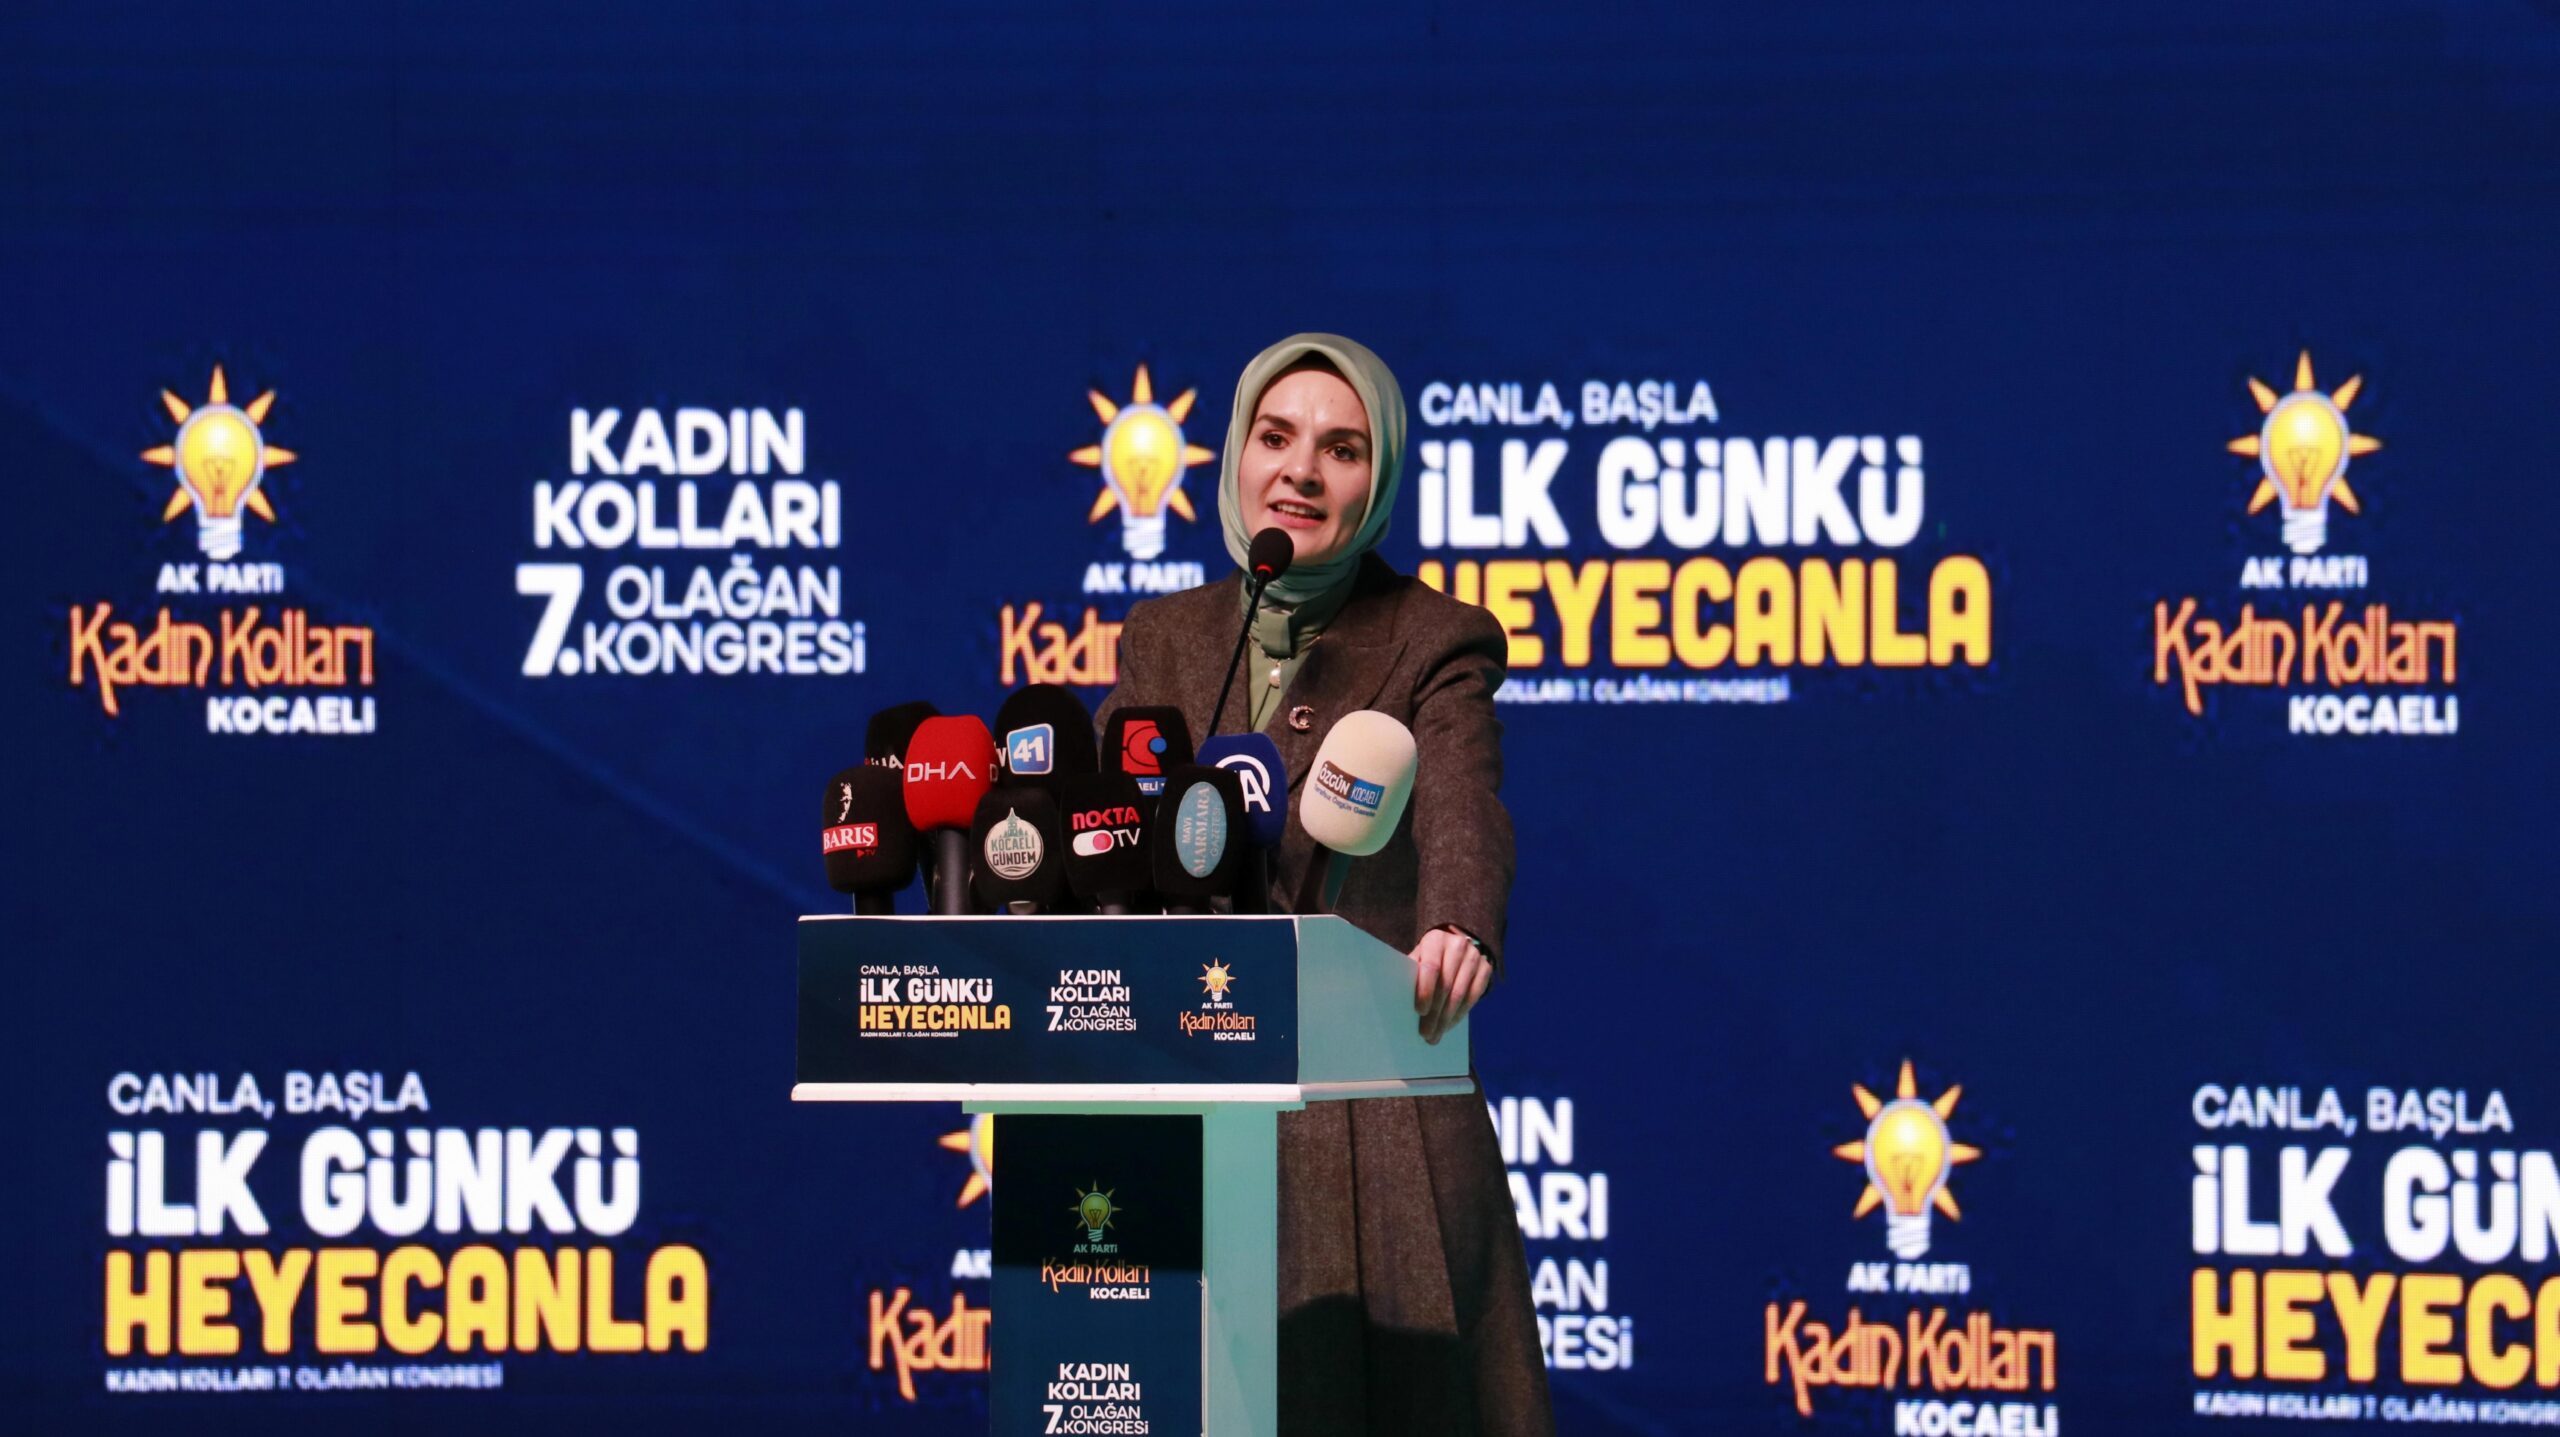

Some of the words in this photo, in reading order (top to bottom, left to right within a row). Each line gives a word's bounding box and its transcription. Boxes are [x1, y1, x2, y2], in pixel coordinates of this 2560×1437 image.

[1420, 383, 1573, 429] CANLA,
[1582, 380, 1718, 431] BAŞLA
[571, 408, 804, 475] KADIN
[1419, 438, 1570, 548] İLK
[1597, 436, 1925, 548] GÜNKÜ
[533, 480, 841, 549] KOLLARI
[157, 563, 200, 592] AK
[606, 553, 840, 619] OLAĞAN
[1082, 563, 1126, 593] AK
[2240, 556, 2284, 588] AK
[515, 563, 583, 676] 7.
[70, 602, 213, 716] Kadın
[221, 606, 373, 688] Kolları
[584, 620, 865, 675] KONGRESİ
[1001, 603, 1123, 686] Kadı
[2154, 597, 2296, 715] Kadın
[2303, 602, 2456, 687] Kolları
[1013, 736, 1045, 763] 41
[908, 761, 976, 782] DHA
[1320, 764, 1351, 796] ÖZGÜN
[823, 826, 876, 848] BARIŞ
[1112, 828, 1140, 848] TV
[1194, 787, 1211, 872] MARMARA
[992, 850, 1037, 866] GÜNDEM
[861, 965, 901, 976] CANLA,
[904, 965, 939, 976] BAŞLA
[1060, 970, 1121, 985] KADIN
[861, 978, 900, 1003] İLK
[908, 978, 993, 1003] GÜNKÜ
[1051, 986, 1130, 1002] KOLLARI
[860, 1004, 1011, 1029] HEYECANLA
[1046, 1005, 1064, 1031] 7.
[1064, 1019, 1136, 1031] KONGRESİ
[1070, 1003, 1130, 1018] OLAĞAN
[1180, 1011, 1216, 1037] Kadın
[107, 1073, 274, 1119] CANLA,
[284, 1071, 429, 1119] BAŞLA
[2193, 1083, 2357, 1137] CANLA,
[2367, 1086, 2514, 1141] BAŞLA
[106, 1130, 269, 1236] İLK
[301, 1126, 640, 1237] GÜNKÜ
[2192, 1145, 2353, 1257] İLK
[2383, 1146, 2560, 1264] GÜN
[1073, 1244, 1088, 1253] AK
[951, 1249, 991, 1279] AK
[1042, 1257, 1092, 1294] Kadın
[1847, 1262, 1890, 1292] AK
[105, 1245, 708, 1355] HEYECANLA
[1059, 1363, 1129, 1380] KADIN
[1765, 1299, 1902, 1418] Kadın
[1907, 1307, 2057, 1392] Kolları
[1048, 1383, 1141, 1400] KOLLARI
[1043, 1404, 1063, 1435] 7.
[1070, 1402, 1141, 1419] OLAĞAN
[1063, 1420, 1149, 1435] KONGRESİ
